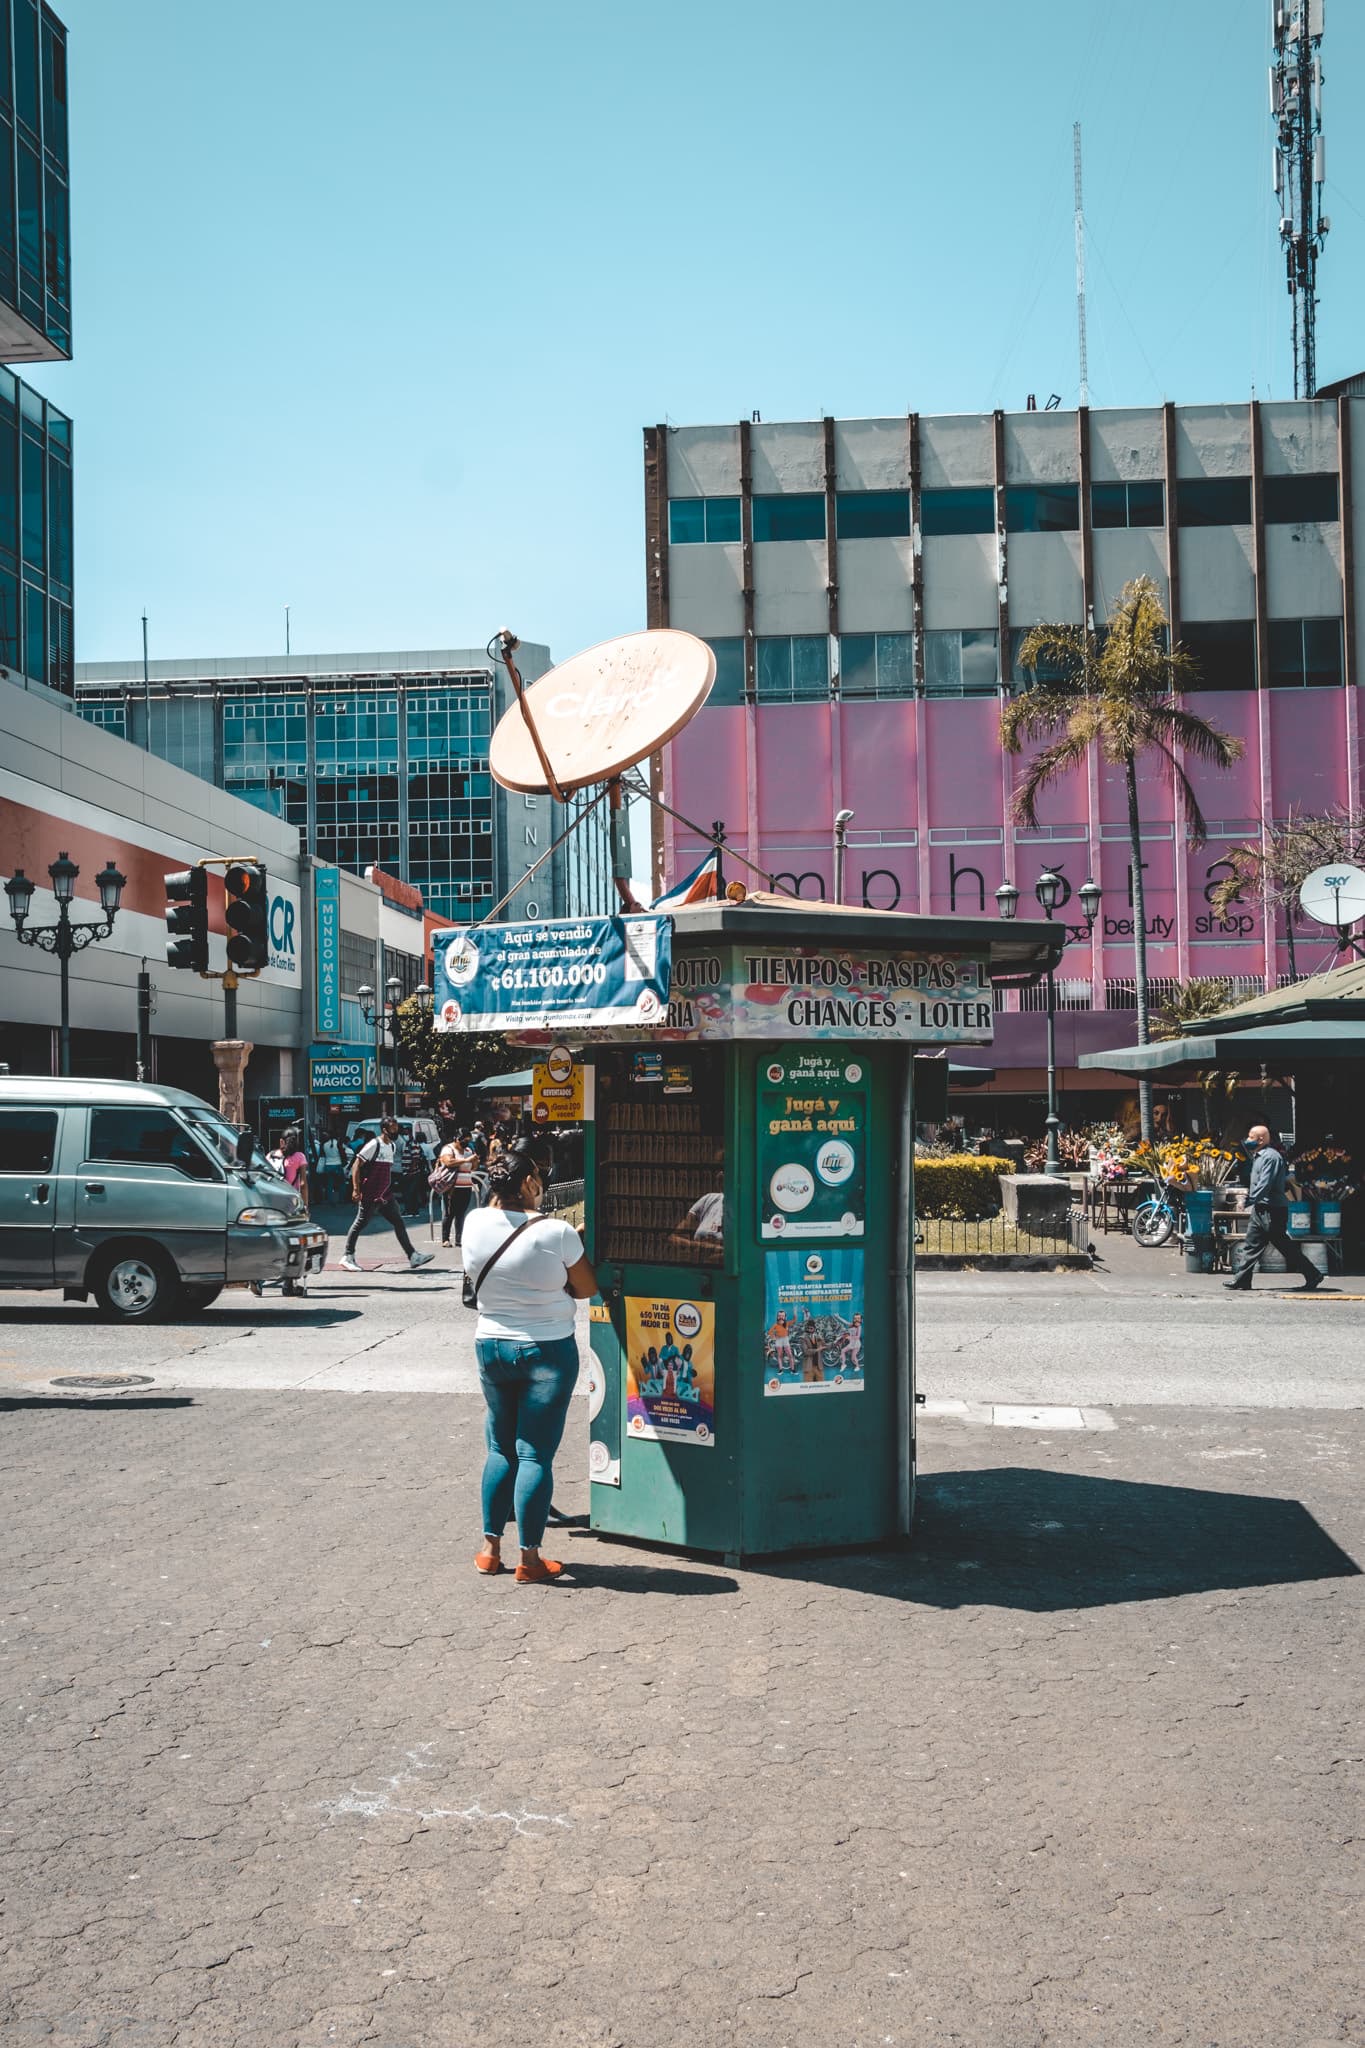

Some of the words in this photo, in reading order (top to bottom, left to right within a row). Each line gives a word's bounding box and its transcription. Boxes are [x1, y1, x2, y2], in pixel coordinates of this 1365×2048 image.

[1323, 875, 1351, 887] SKY
[266, 895, 295, 955] CR
[322, 903, 334, 959] MUNDO
[1195, 911, 1254, 937] shop
[503, 930, 533, 946] Aquí
[535, 931, 549, 942] se
[550, 924, 593, 941] vendió
[497, 950, 506, 962] el
[507, 950, 531, 963] gran
[532, 946, 588, 961] acumulado
[588, 944, 602, 955] de
[745, 957, 852, 986] TIEMPOS
[787, 999, 897, 1028] CHANCES
[920, 1002, 991, 1028] LOTER
[315, 1064, 360, 1075] MUNDO
[799, 1056, 823, 1068] Jugá
[824, 1058, 832, 1068] y
[312, 1074, 362, 1087] MÁGICO
[789, 1067, 815, 1080] ganá
[817, 1067, 840, 1080] aquí
[784, 1096, 826, 1115] Jugá
[828, 1099, 840, 1115] y
[769, 1116, 814, 1136] ganá
[816, 1116, 856, 1136] aquí
[640, 1311, 652, 1319] 650
[653, 1311, 670, 1320] VECES
[651, 1303, 659, 1311] TU
[641, 1320, 660, 1328] MEJOR
[662, 1321, 670, 1329] EN
